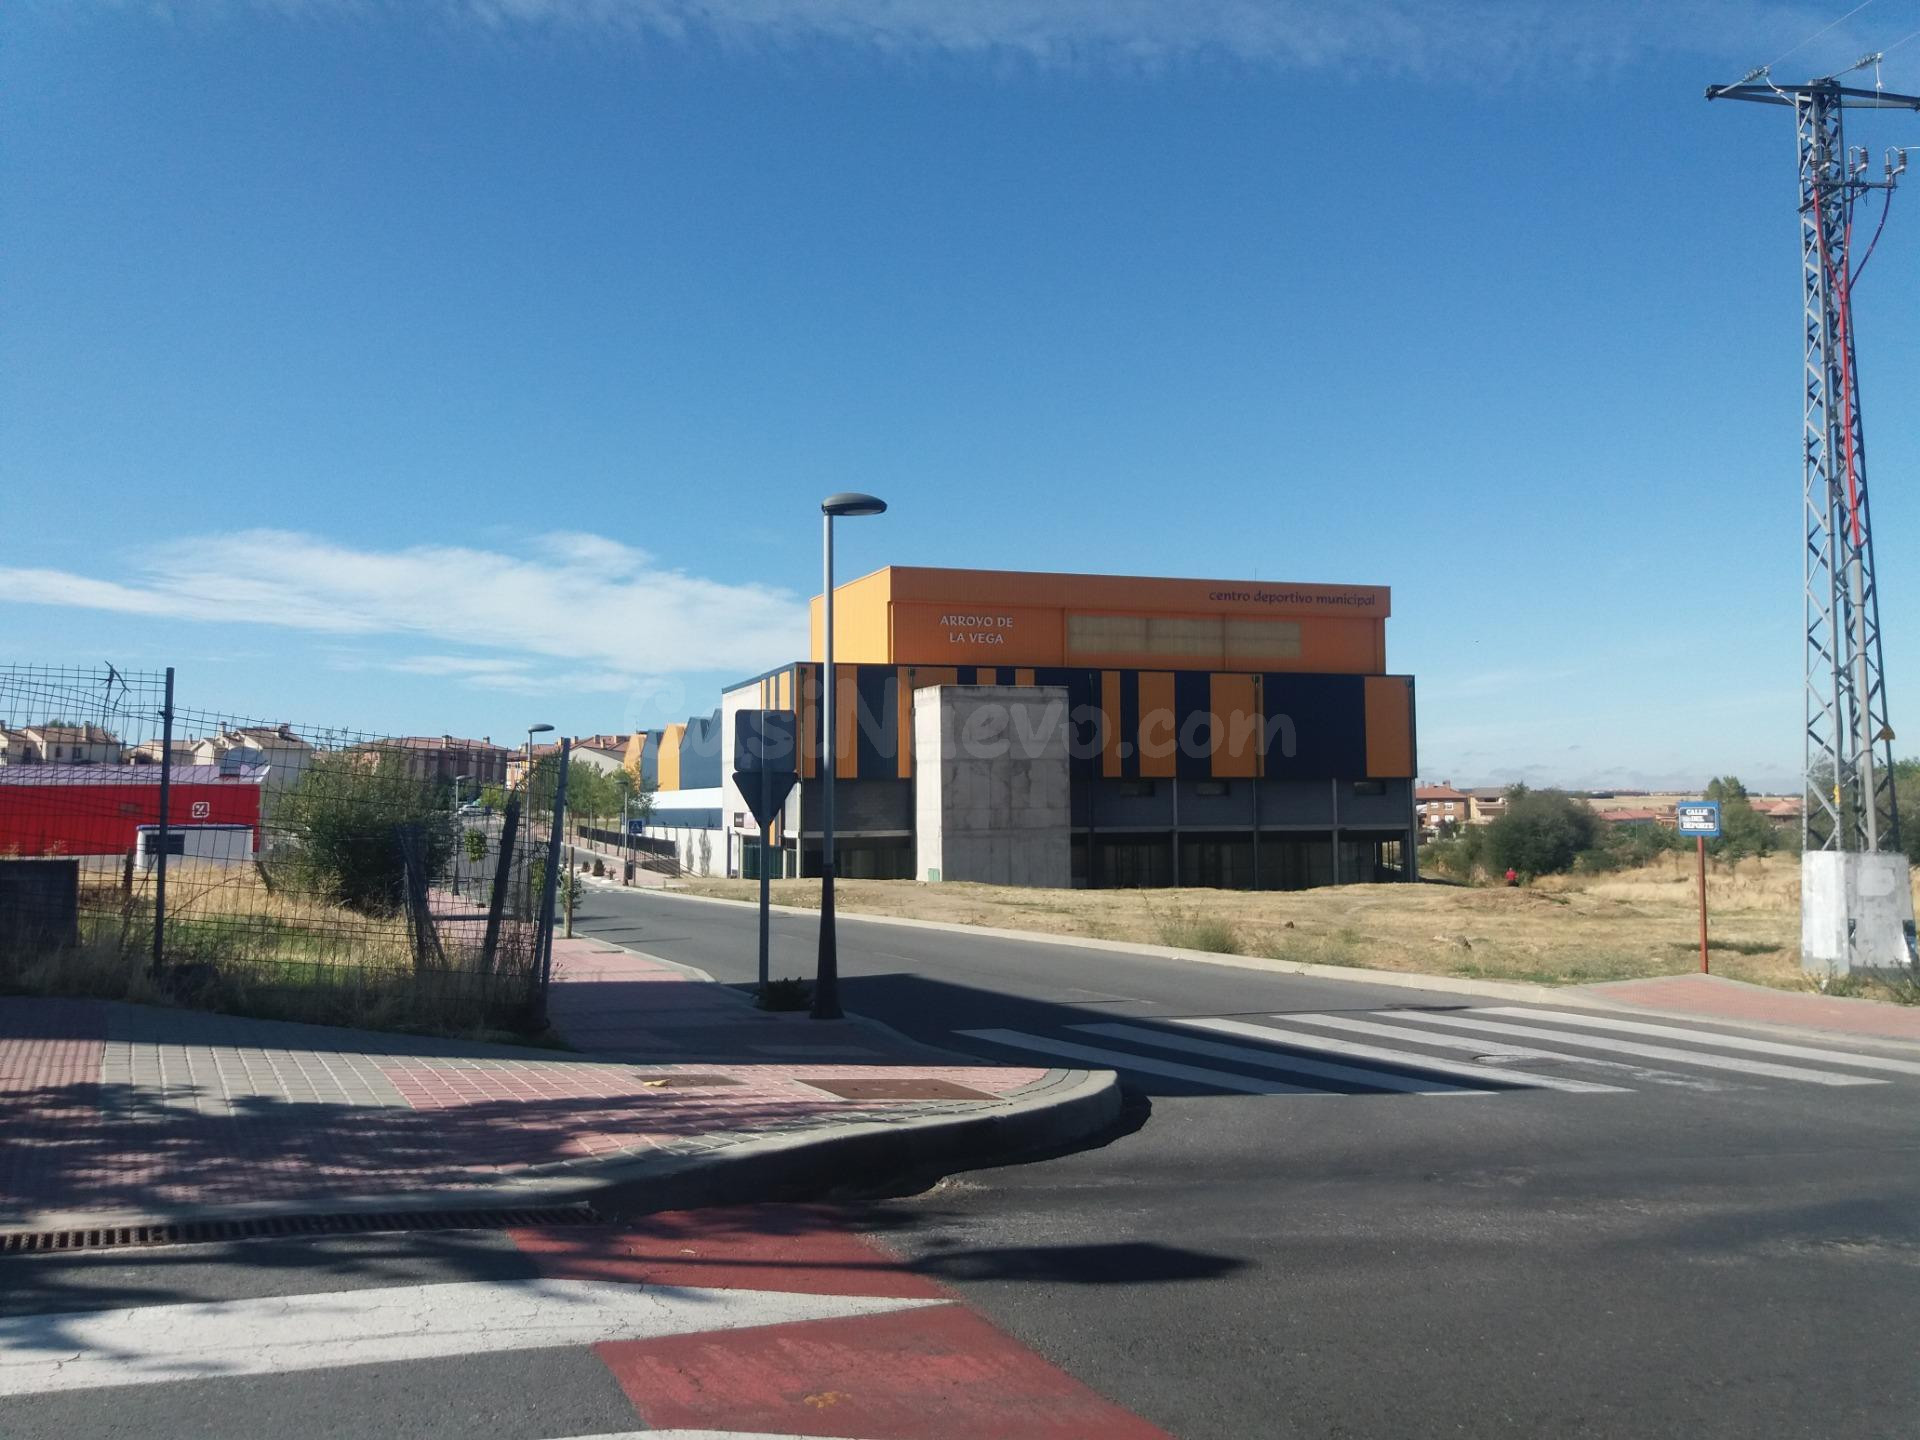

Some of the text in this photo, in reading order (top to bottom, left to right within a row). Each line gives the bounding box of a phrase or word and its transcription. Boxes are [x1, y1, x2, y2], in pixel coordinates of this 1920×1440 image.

[1209, 591, 1375, 607] centro deportivo municipal
[940, 615, 1013, 628] ARROYO DE
[949, 632, 1004, 644] LA VEGA
